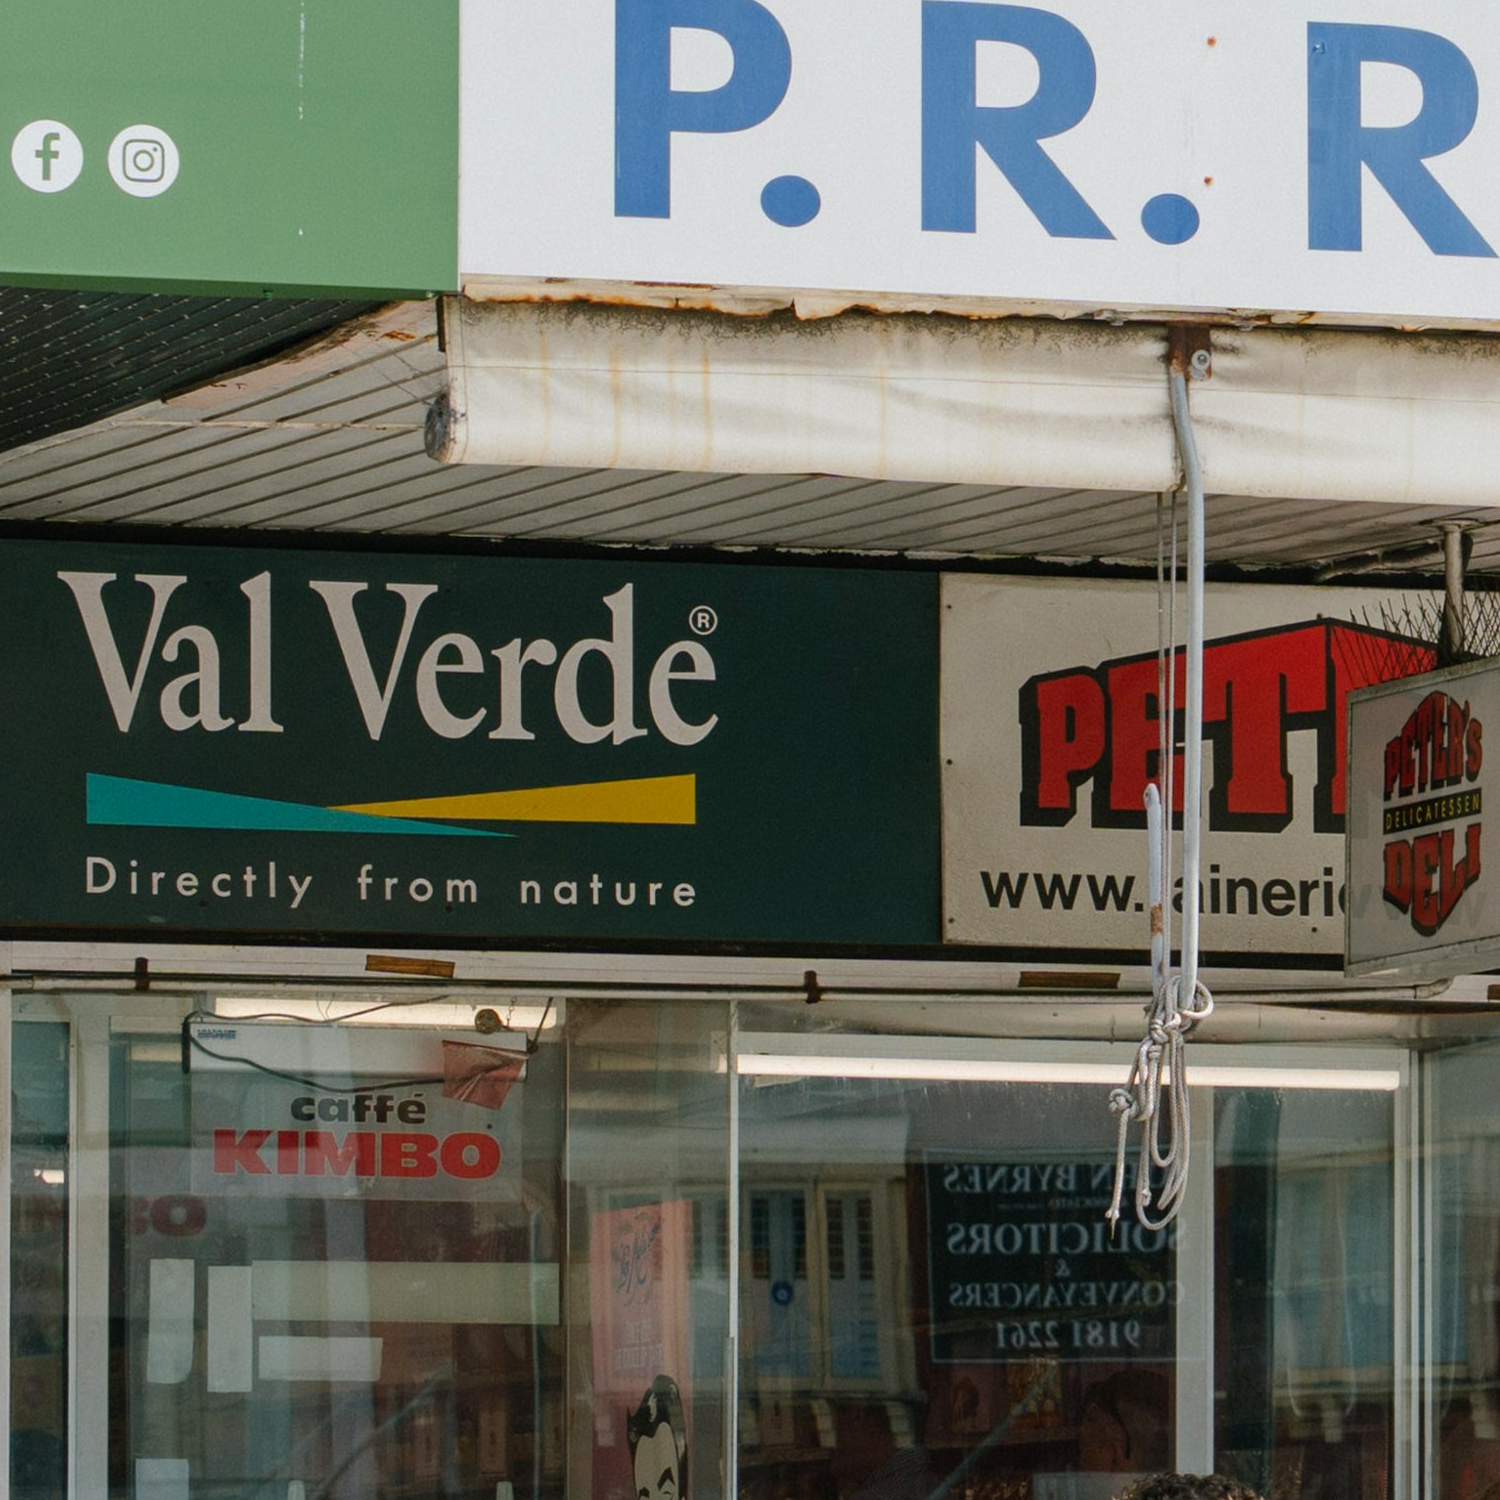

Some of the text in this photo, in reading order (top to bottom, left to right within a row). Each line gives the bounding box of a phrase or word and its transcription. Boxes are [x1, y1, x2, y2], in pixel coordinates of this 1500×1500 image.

[919, 0, 1202, 247] R.
[57, 569, 284, 736] Val
[1383, 690, 1482, 801] PETER'S
[1386, 794, 1481, 831] DELICATESSEN
[85, 856, 697, 908] Directly from nature
[1383, 822, 1482, 937] DELI
[212, 1128, 501, 1179] KIMBO
